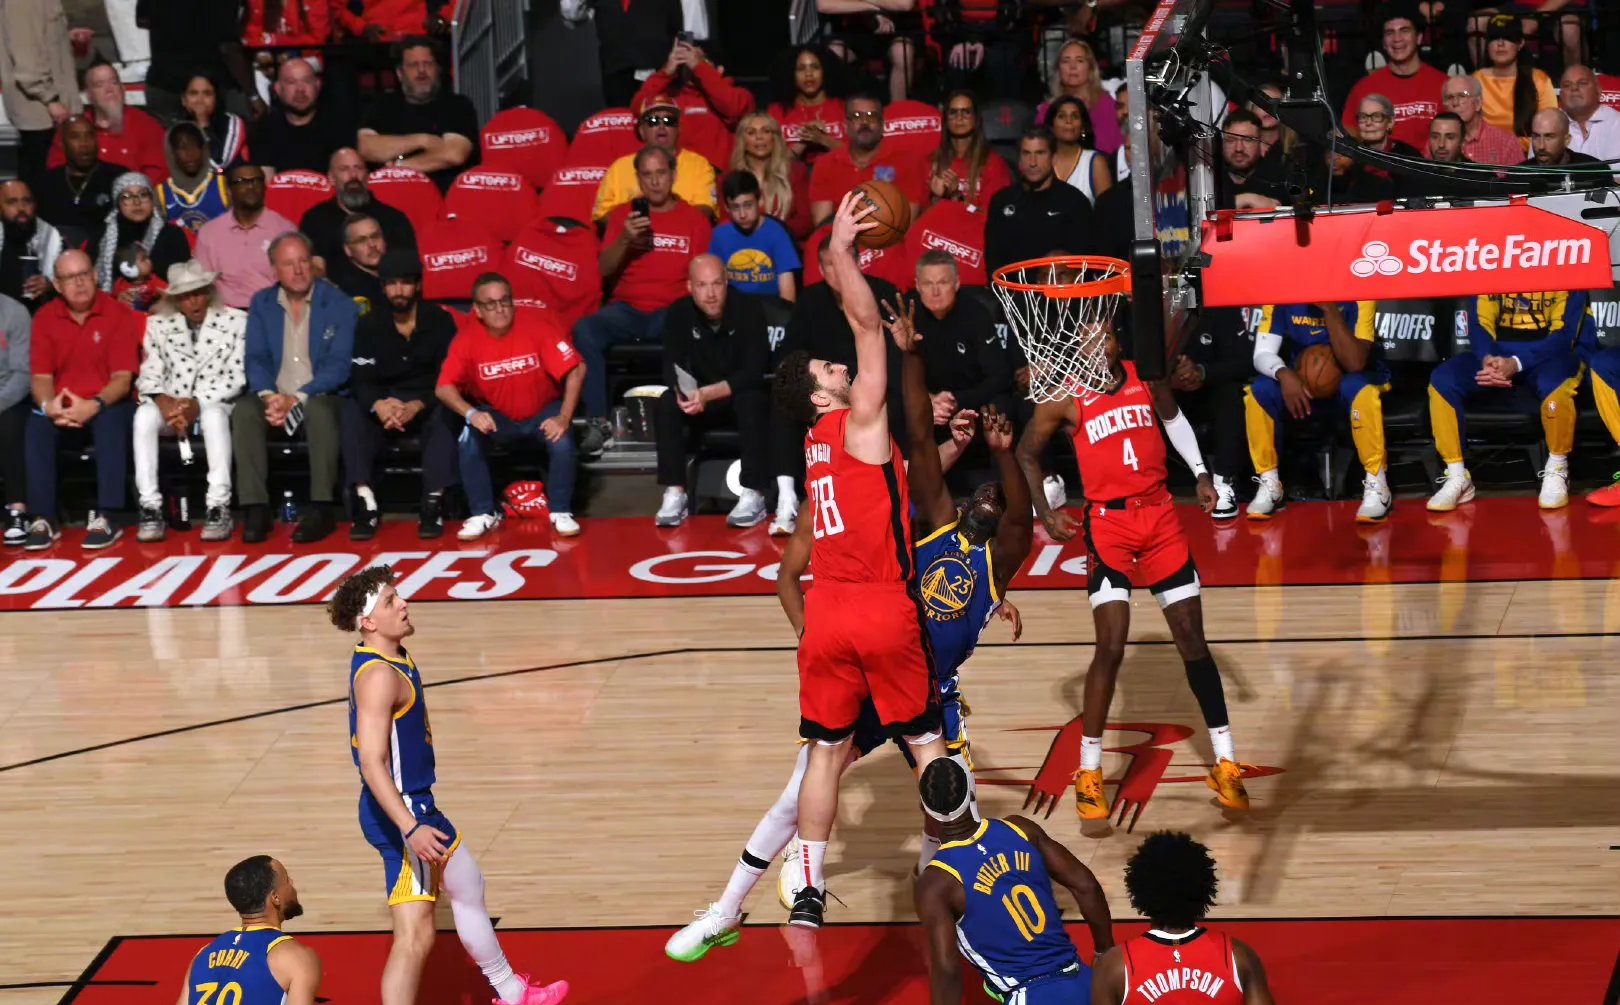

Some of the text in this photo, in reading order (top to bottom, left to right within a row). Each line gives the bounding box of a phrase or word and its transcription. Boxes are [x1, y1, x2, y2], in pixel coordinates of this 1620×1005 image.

[1407, 234, 1591, 274] State Farm
[1375, 311, 1436, 340] LAYOFFS
[1085, 403, 1153, 445] ROCKETS
[1123, 437, 1139, 471] 4
[810, 475, 845, 540] 28
[949, 575, 972, 594] 23
[973, 850, 1030, 895] BUTLER III
[1001, 884, 1046, 942] 10
[208, 948, 250, 970] CURRY
[1136, 967, 1225, 1003] THOMPSON
